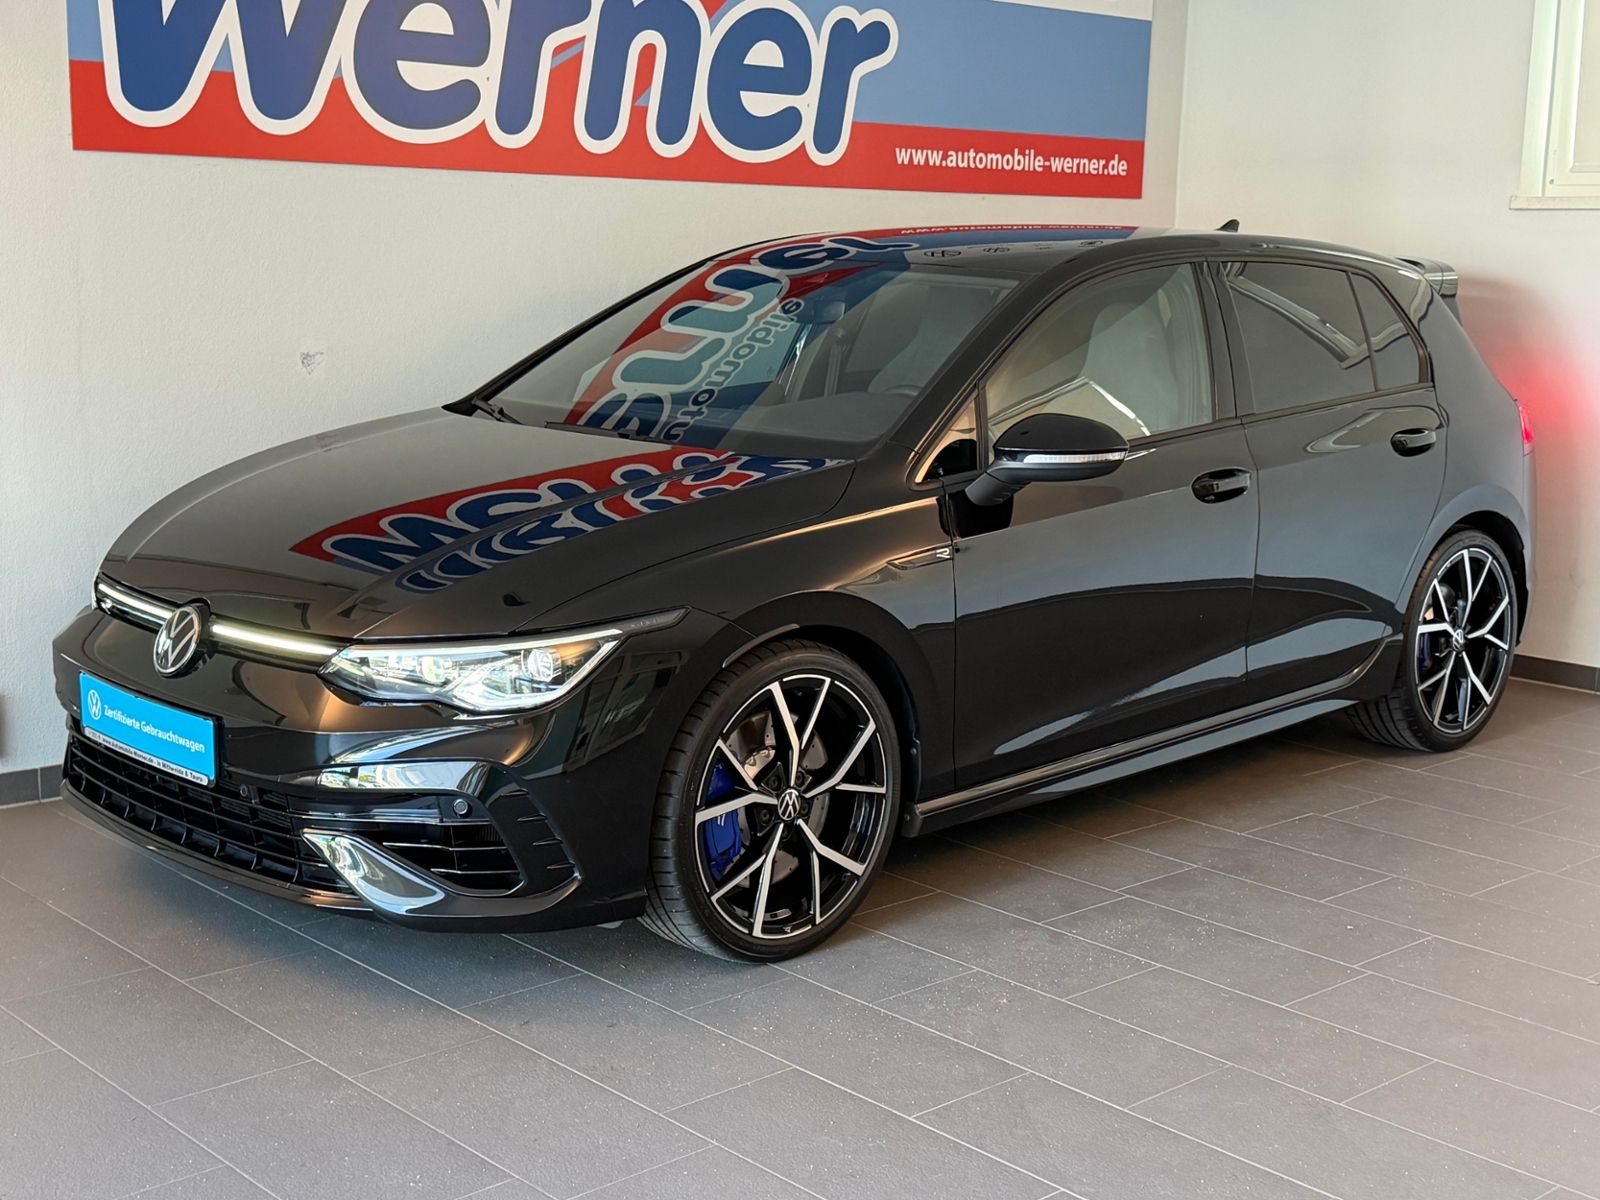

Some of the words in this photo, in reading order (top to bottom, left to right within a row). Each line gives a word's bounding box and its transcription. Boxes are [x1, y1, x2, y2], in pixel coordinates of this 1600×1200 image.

[895, 147, 1128, 176] www.automobile-werner.de
[104, 705, 140, 730] Zertifizierte
[141, 721, 205, 752] Gebrauchtwagen
